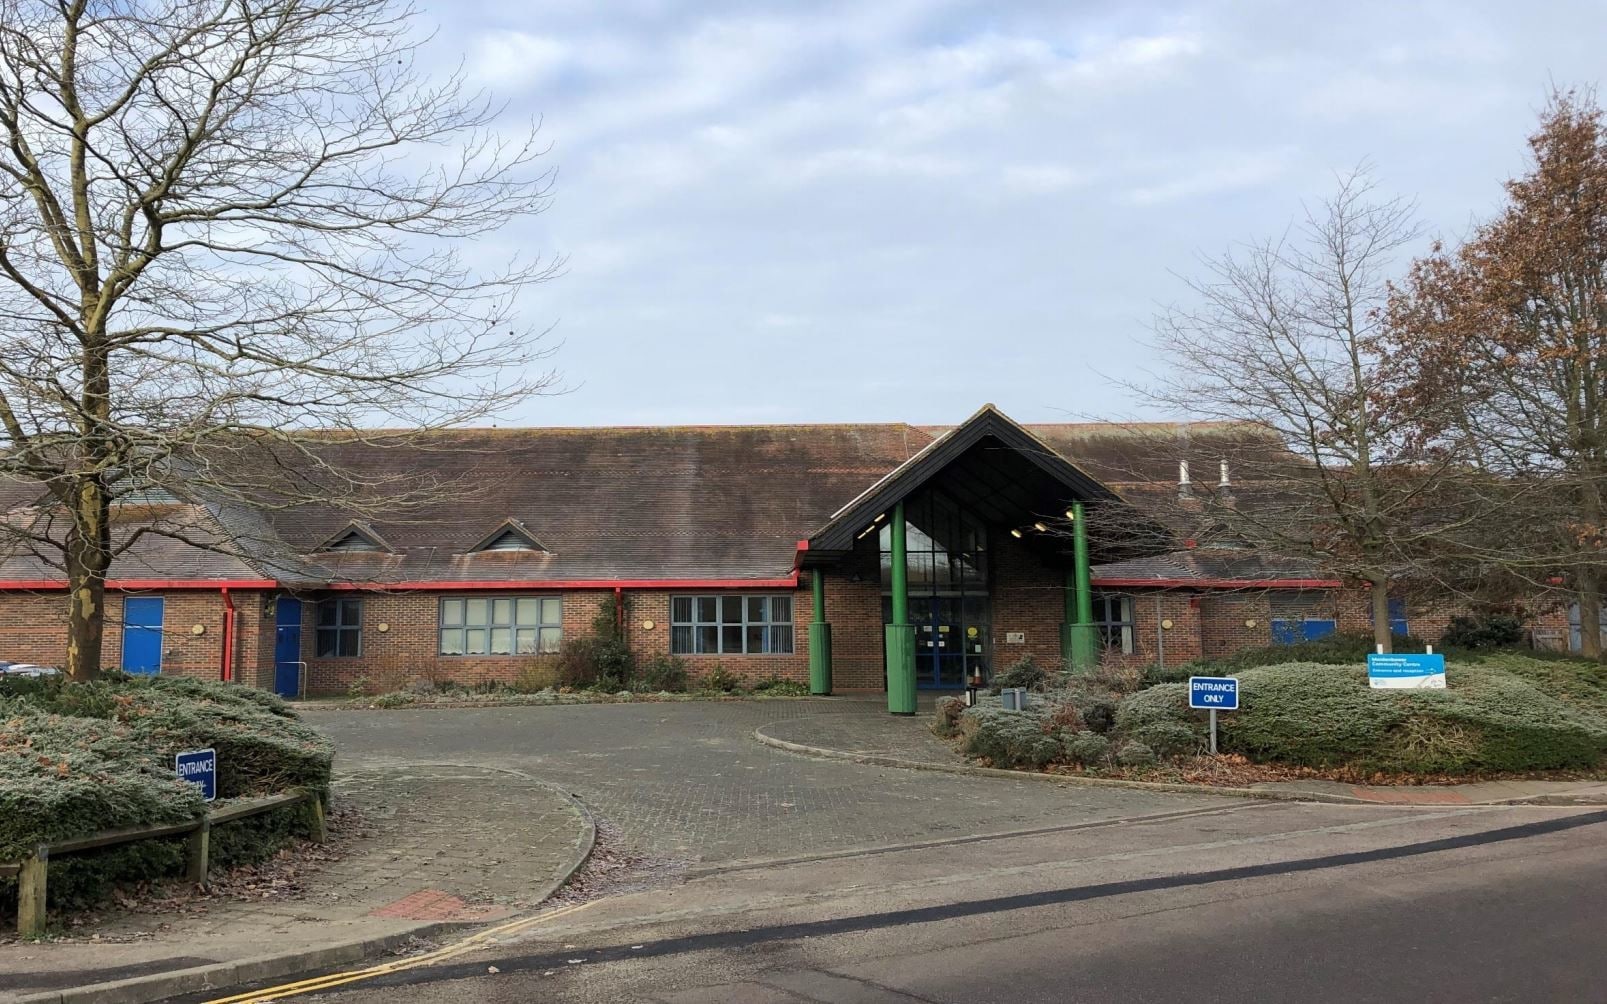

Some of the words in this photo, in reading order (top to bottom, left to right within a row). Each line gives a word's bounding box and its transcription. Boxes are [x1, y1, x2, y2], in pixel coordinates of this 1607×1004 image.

[1193, 683, 1235, 692] ENTRANCE
[1203, 694, 1224, 703] ONLY
[178, 759, 212, 776] ENTRANCE
